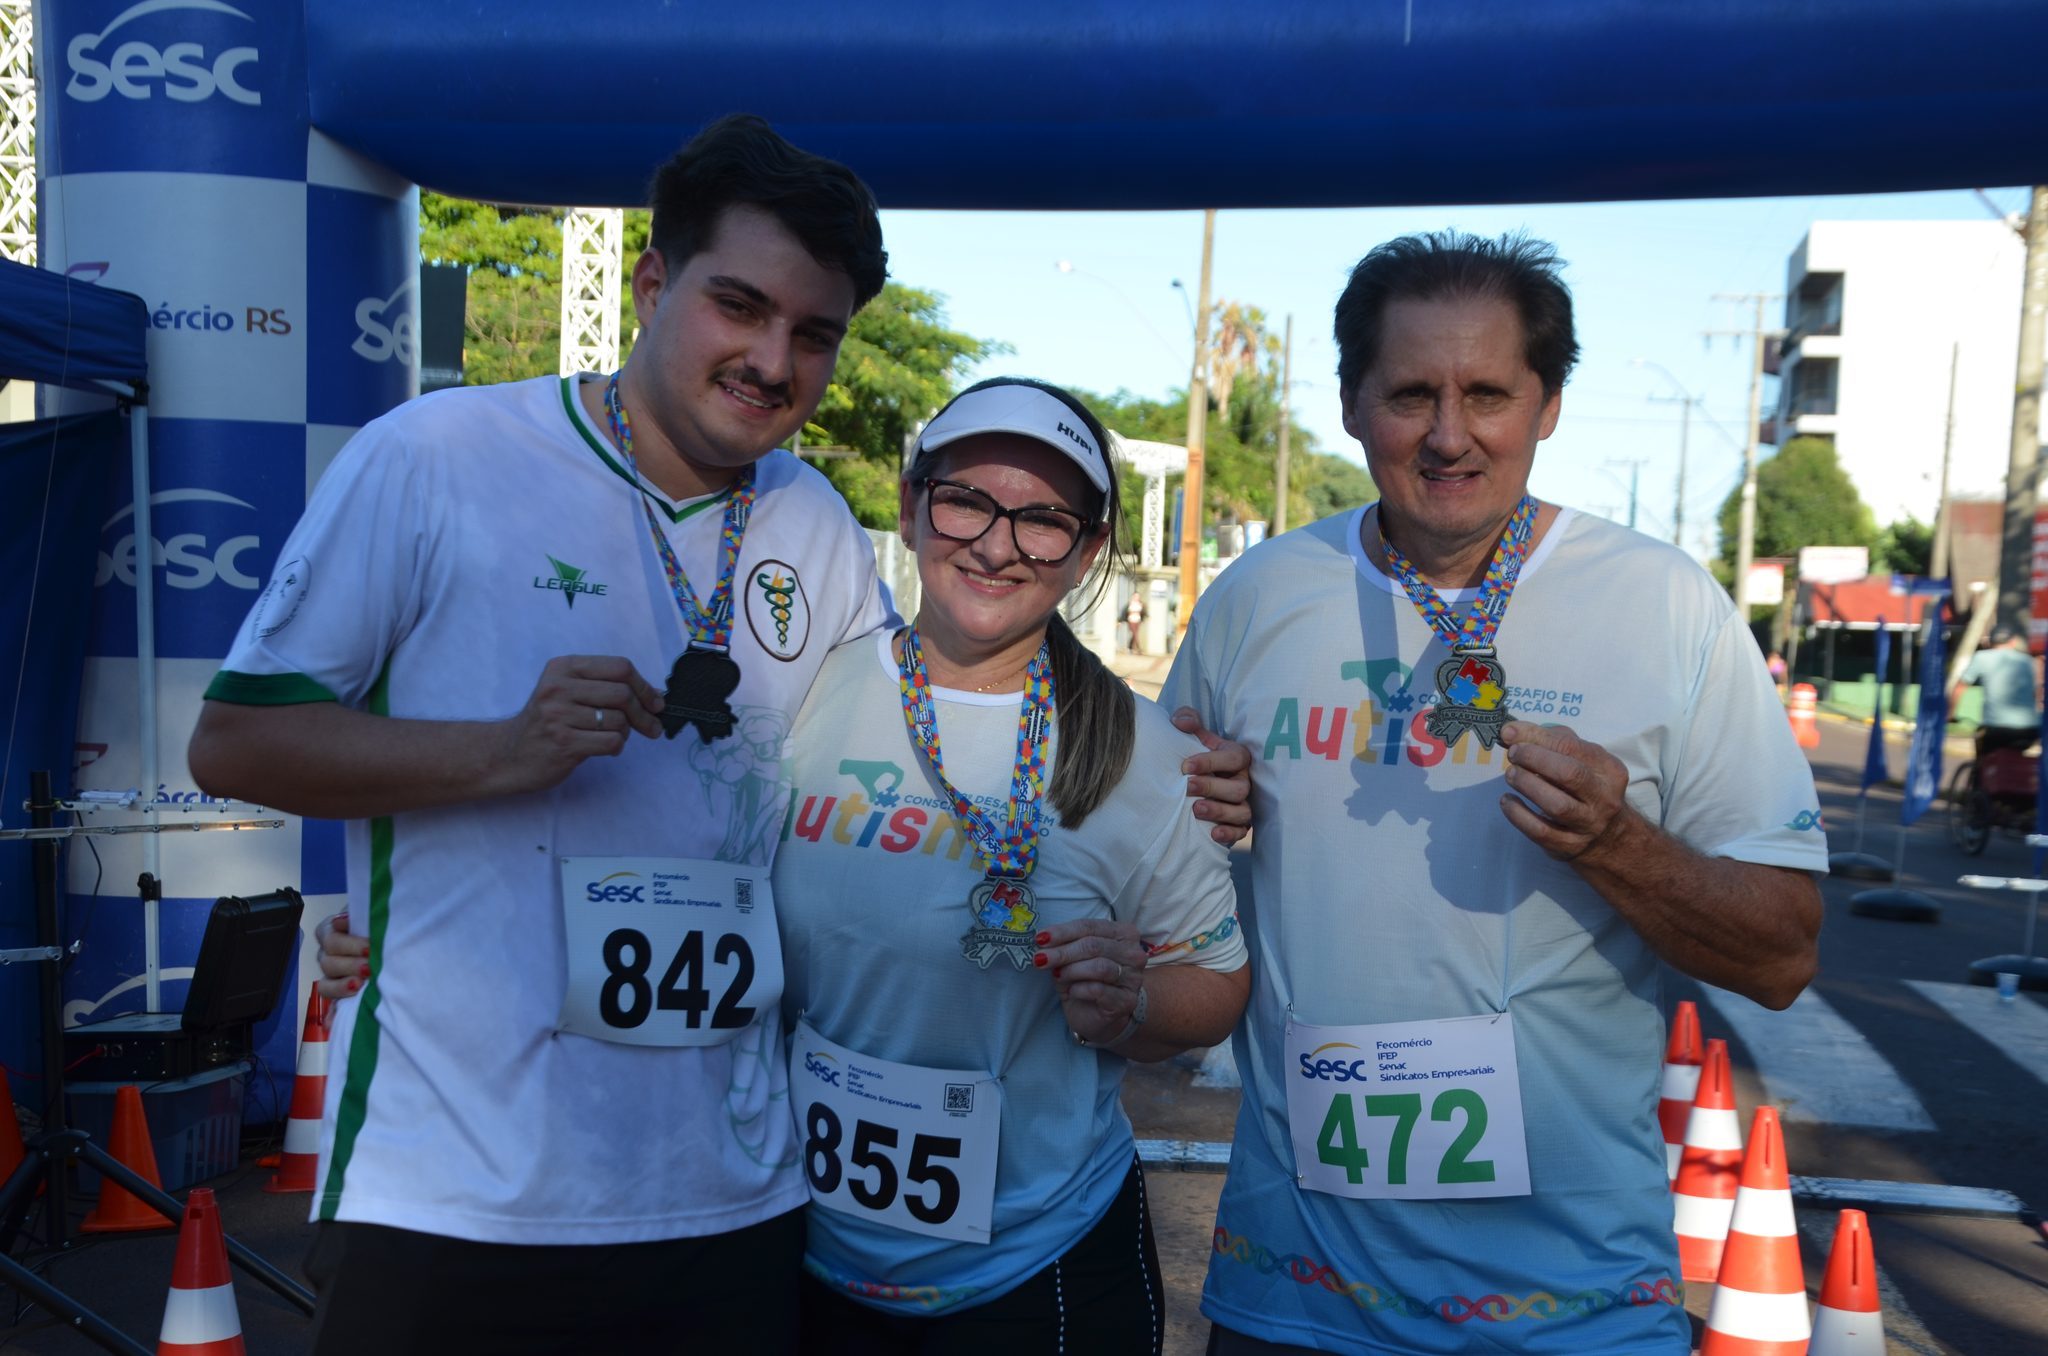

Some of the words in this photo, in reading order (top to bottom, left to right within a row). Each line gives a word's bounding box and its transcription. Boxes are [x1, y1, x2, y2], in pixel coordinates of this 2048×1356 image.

[147, 302, 234, 331] ércio
[246, 307, 292, 336] RS
[352, 297, 420, 365] Se
[533, 576, 609, 597] LEAGUE
[1505, 686, 1557, 701] ESAFIO
[1561, 692, 1583, 704] EM
[1558, 705, 1580, 717] AO
[1263, 697, 1512, 769] Autis
[974, 795, 1009, 812] DESA
[600, 928, 757, 1029] 842
[1376, 1038, 1433, 1050] Fecomércio
[1377, 1051, 1398, 1061] IFEP
[1299, 1053, 1367, 1082] Sesc
[1380, 1071, 1430, 1082] Sindicatos
[1431, 1065, 1496, 1080] Empresariais
[1316, 1088, 1496, 1185] 472
[805, 1101, 962, 1225] 855
